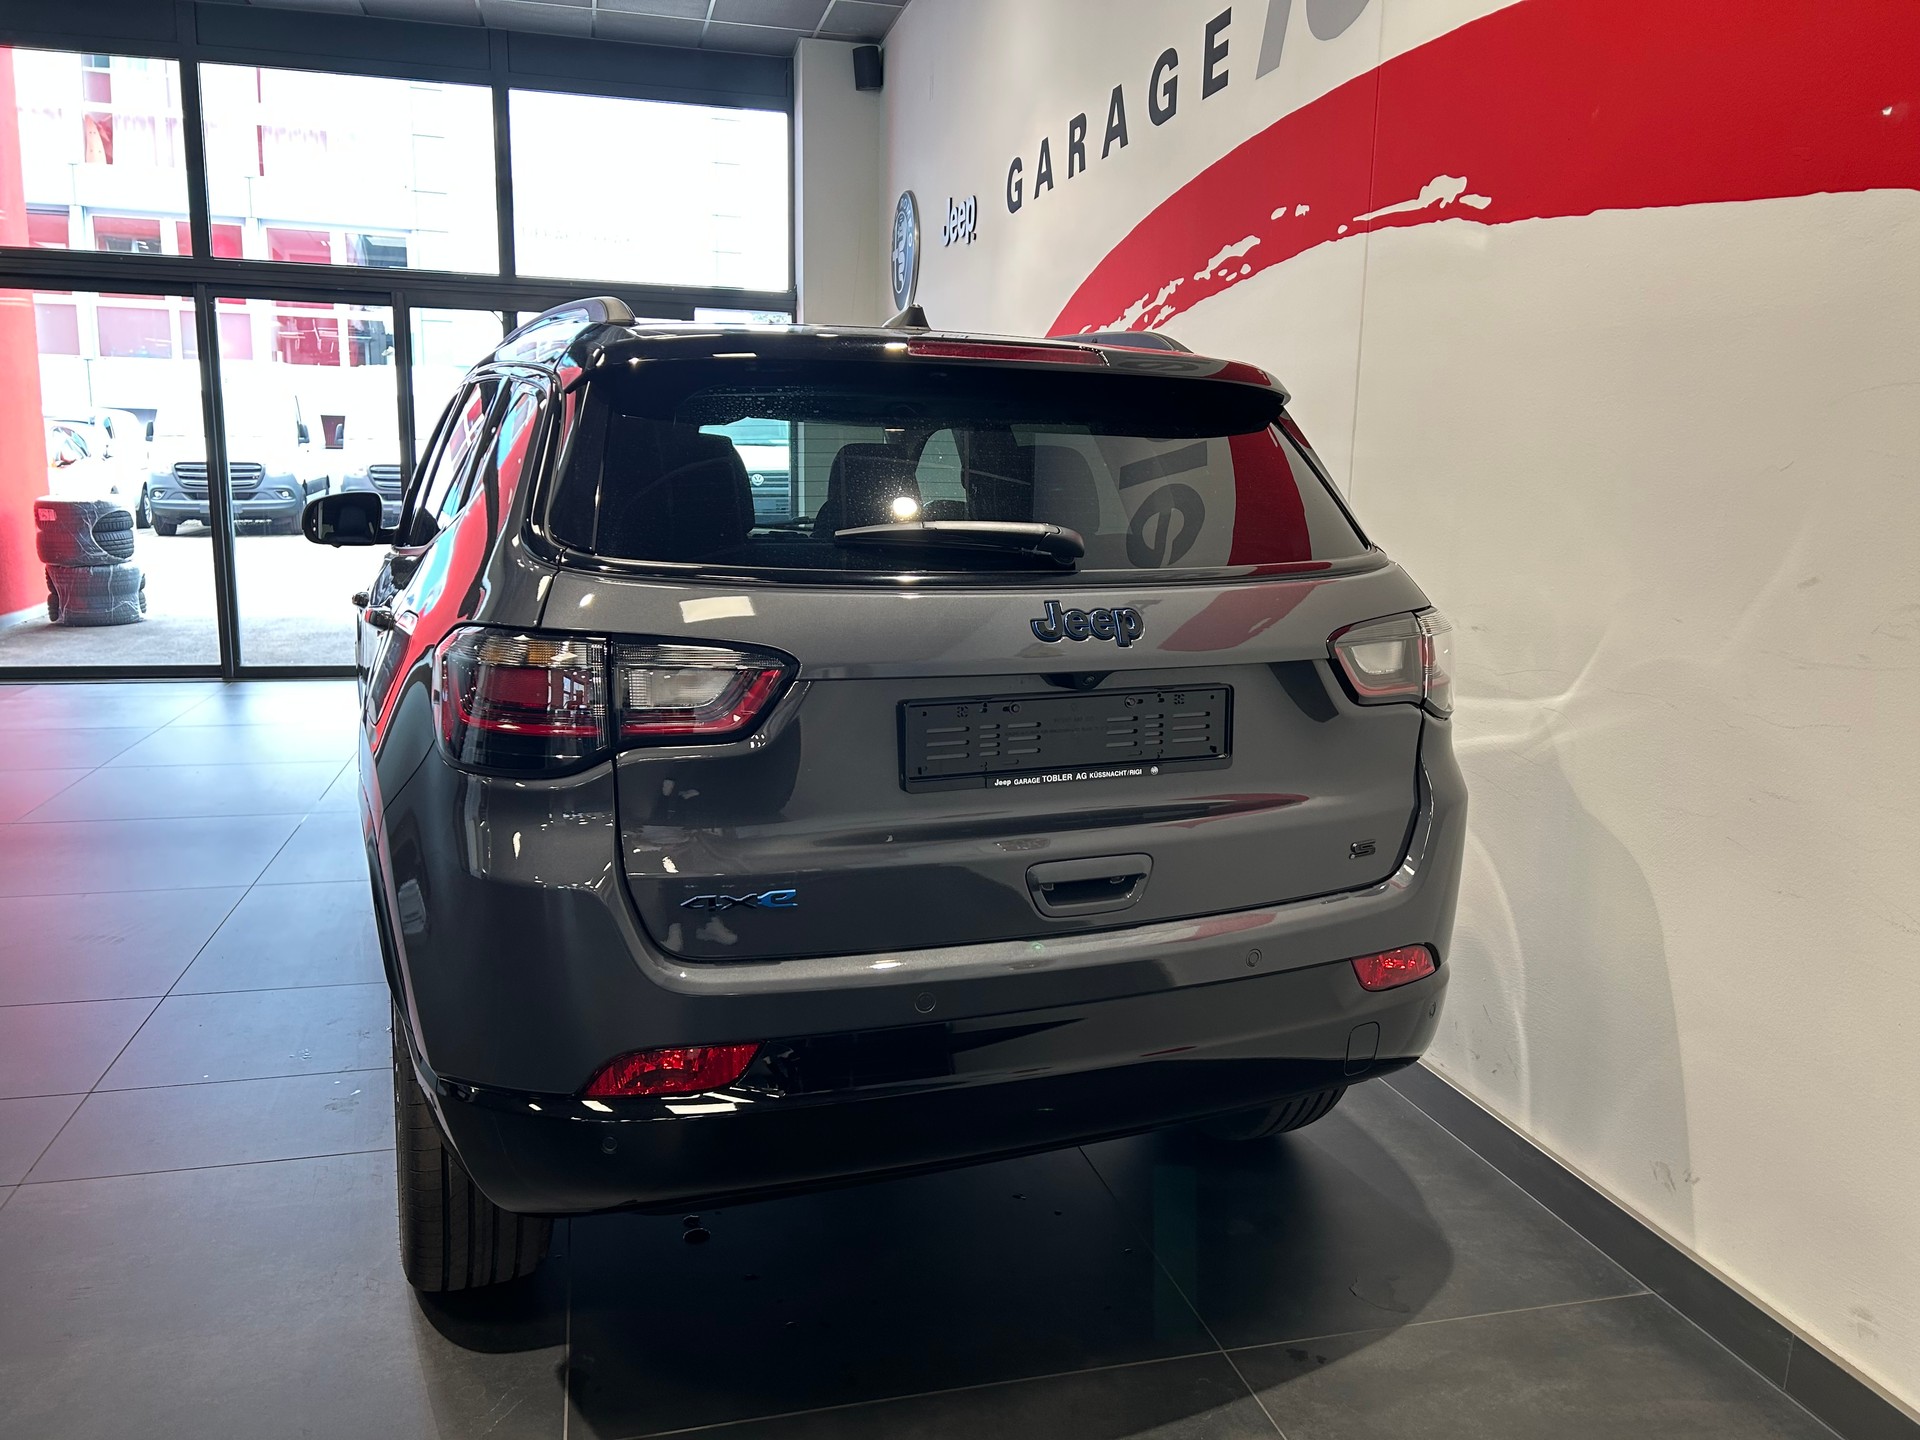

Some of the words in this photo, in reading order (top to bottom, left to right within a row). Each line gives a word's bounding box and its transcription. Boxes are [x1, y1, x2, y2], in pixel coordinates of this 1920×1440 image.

[1006, 7, 1232, 213] GARAGE
[943, 195, 977, 247] Jeep
[1030, 600, 1145, 648] Jeep
[994, 778, 1012, 787] Jeep
[1013, 776, 1041, 786] GARAGE
[1042, 773, 1073, 783] TOBLER
[1075, 771, 1088, 781] AG
[1349, 838, 1377, 860] S
